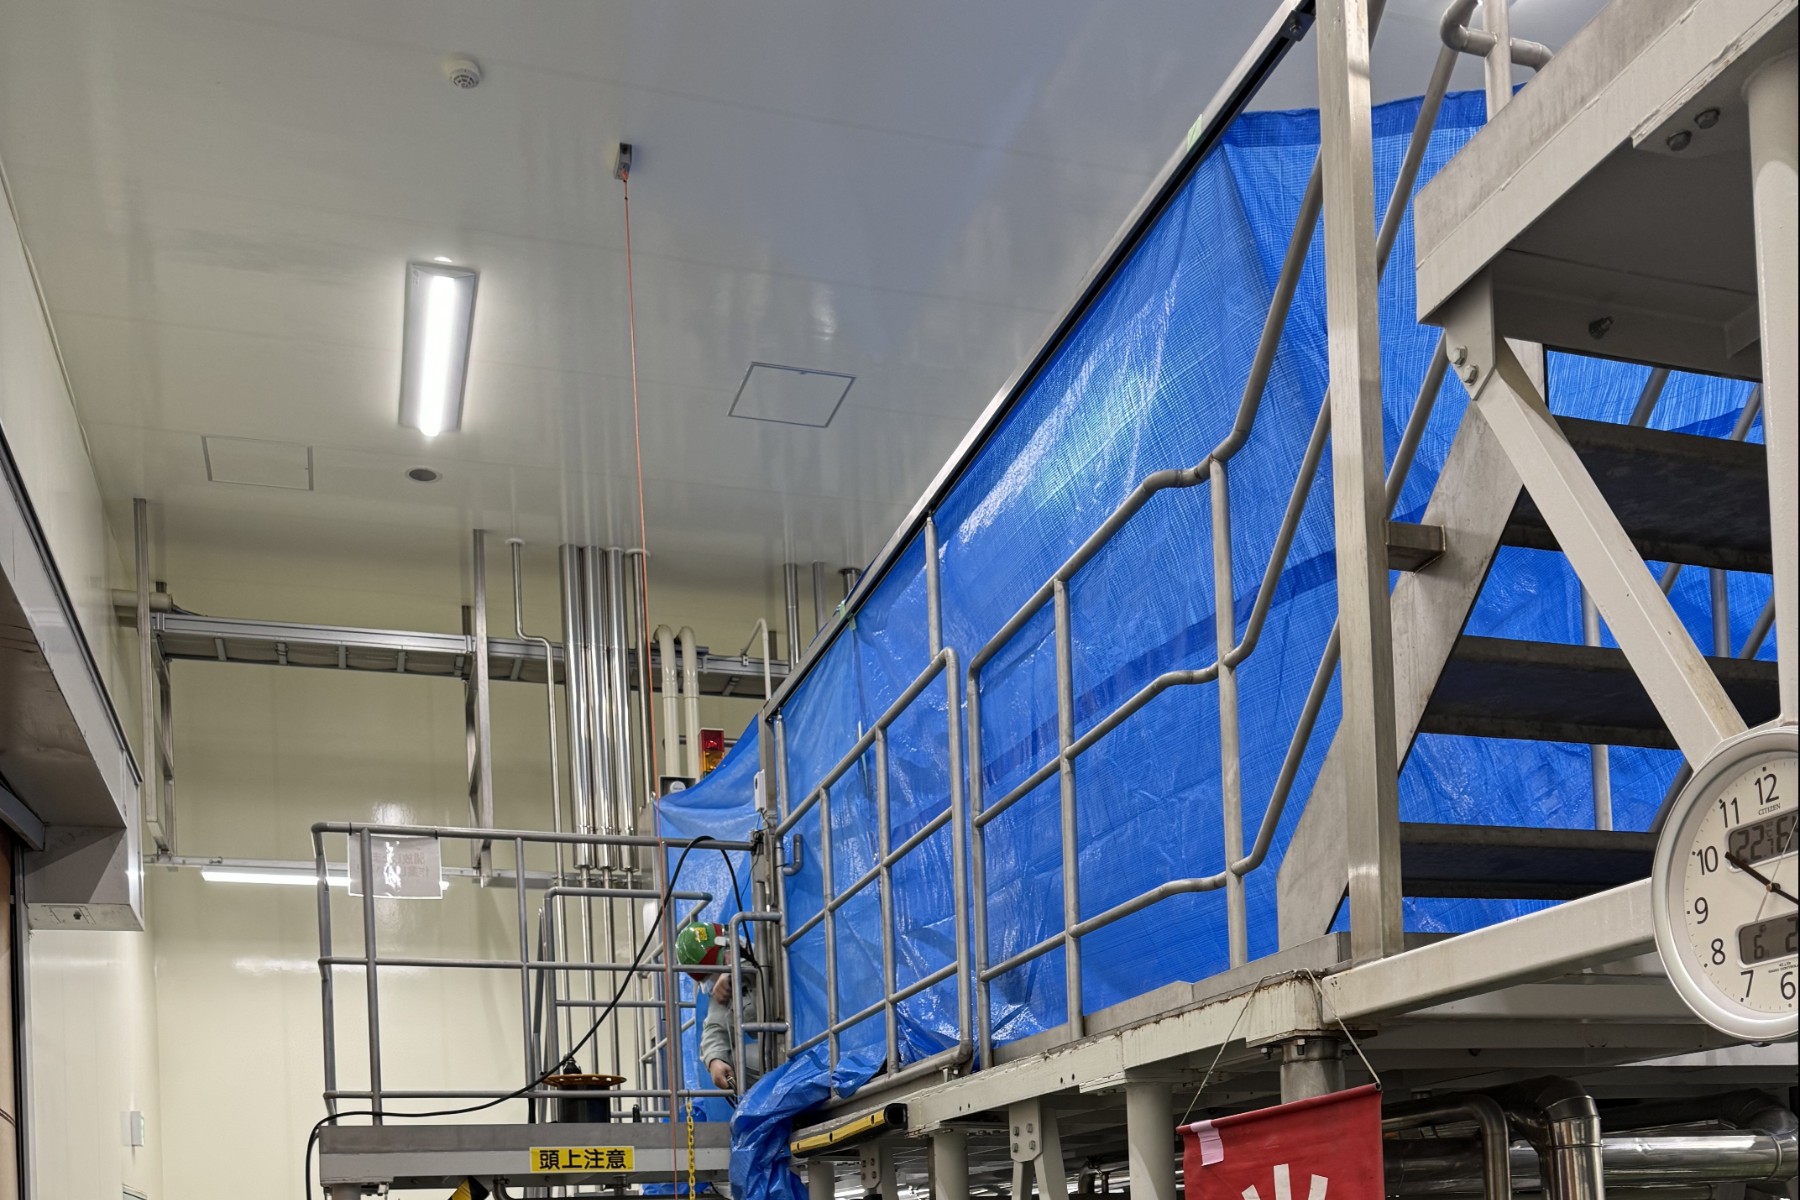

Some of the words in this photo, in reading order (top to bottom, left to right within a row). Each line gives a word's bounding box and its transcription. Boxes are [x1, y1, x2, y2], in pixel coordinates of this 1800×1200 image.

[1754, 773, 1780, 806] 12
[1719, 797, 1740, 828] 11
[1758, 803, 1781, 816] CITIZEN
[1697, 845, 1719, 876] 10
[1694, 896, 1709, 925] 9
[1711, 938, 1726, 966] 8
[1740, 969, 1754, 998] 7
[1780, 971, 1796, 1001] 6
[539, 1148, 627, 1170] 頭上注意
